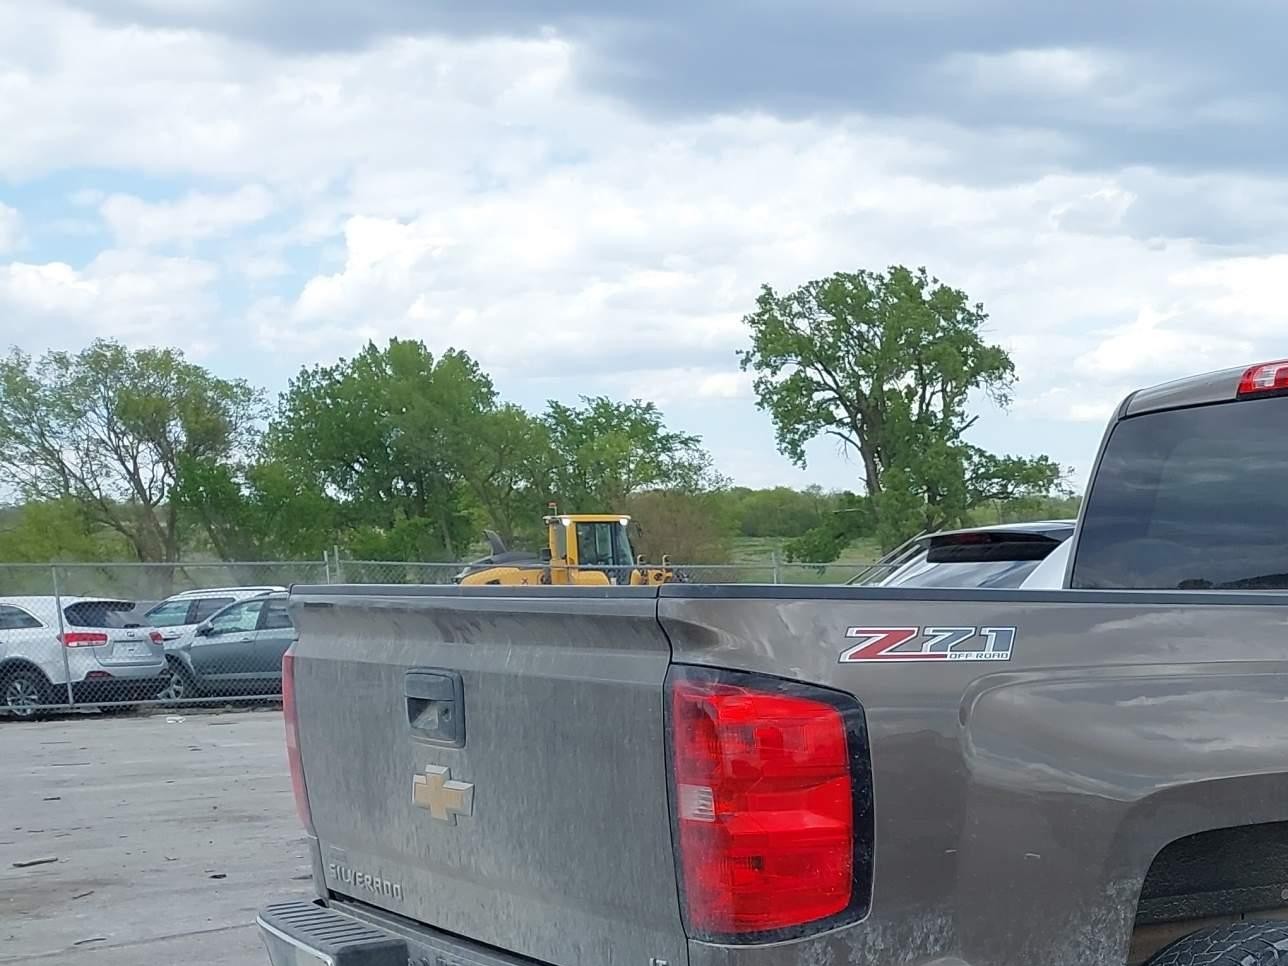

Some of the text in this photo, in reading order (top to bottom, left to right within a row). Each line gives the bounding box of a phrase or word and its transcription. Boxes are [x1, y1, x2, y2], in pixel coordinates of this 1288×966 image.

[839, 626, 1017, 664] Z71
[950, 652, 1010, 660] OFF ROAD
[329, 863, 403, 901] SILVERADO
